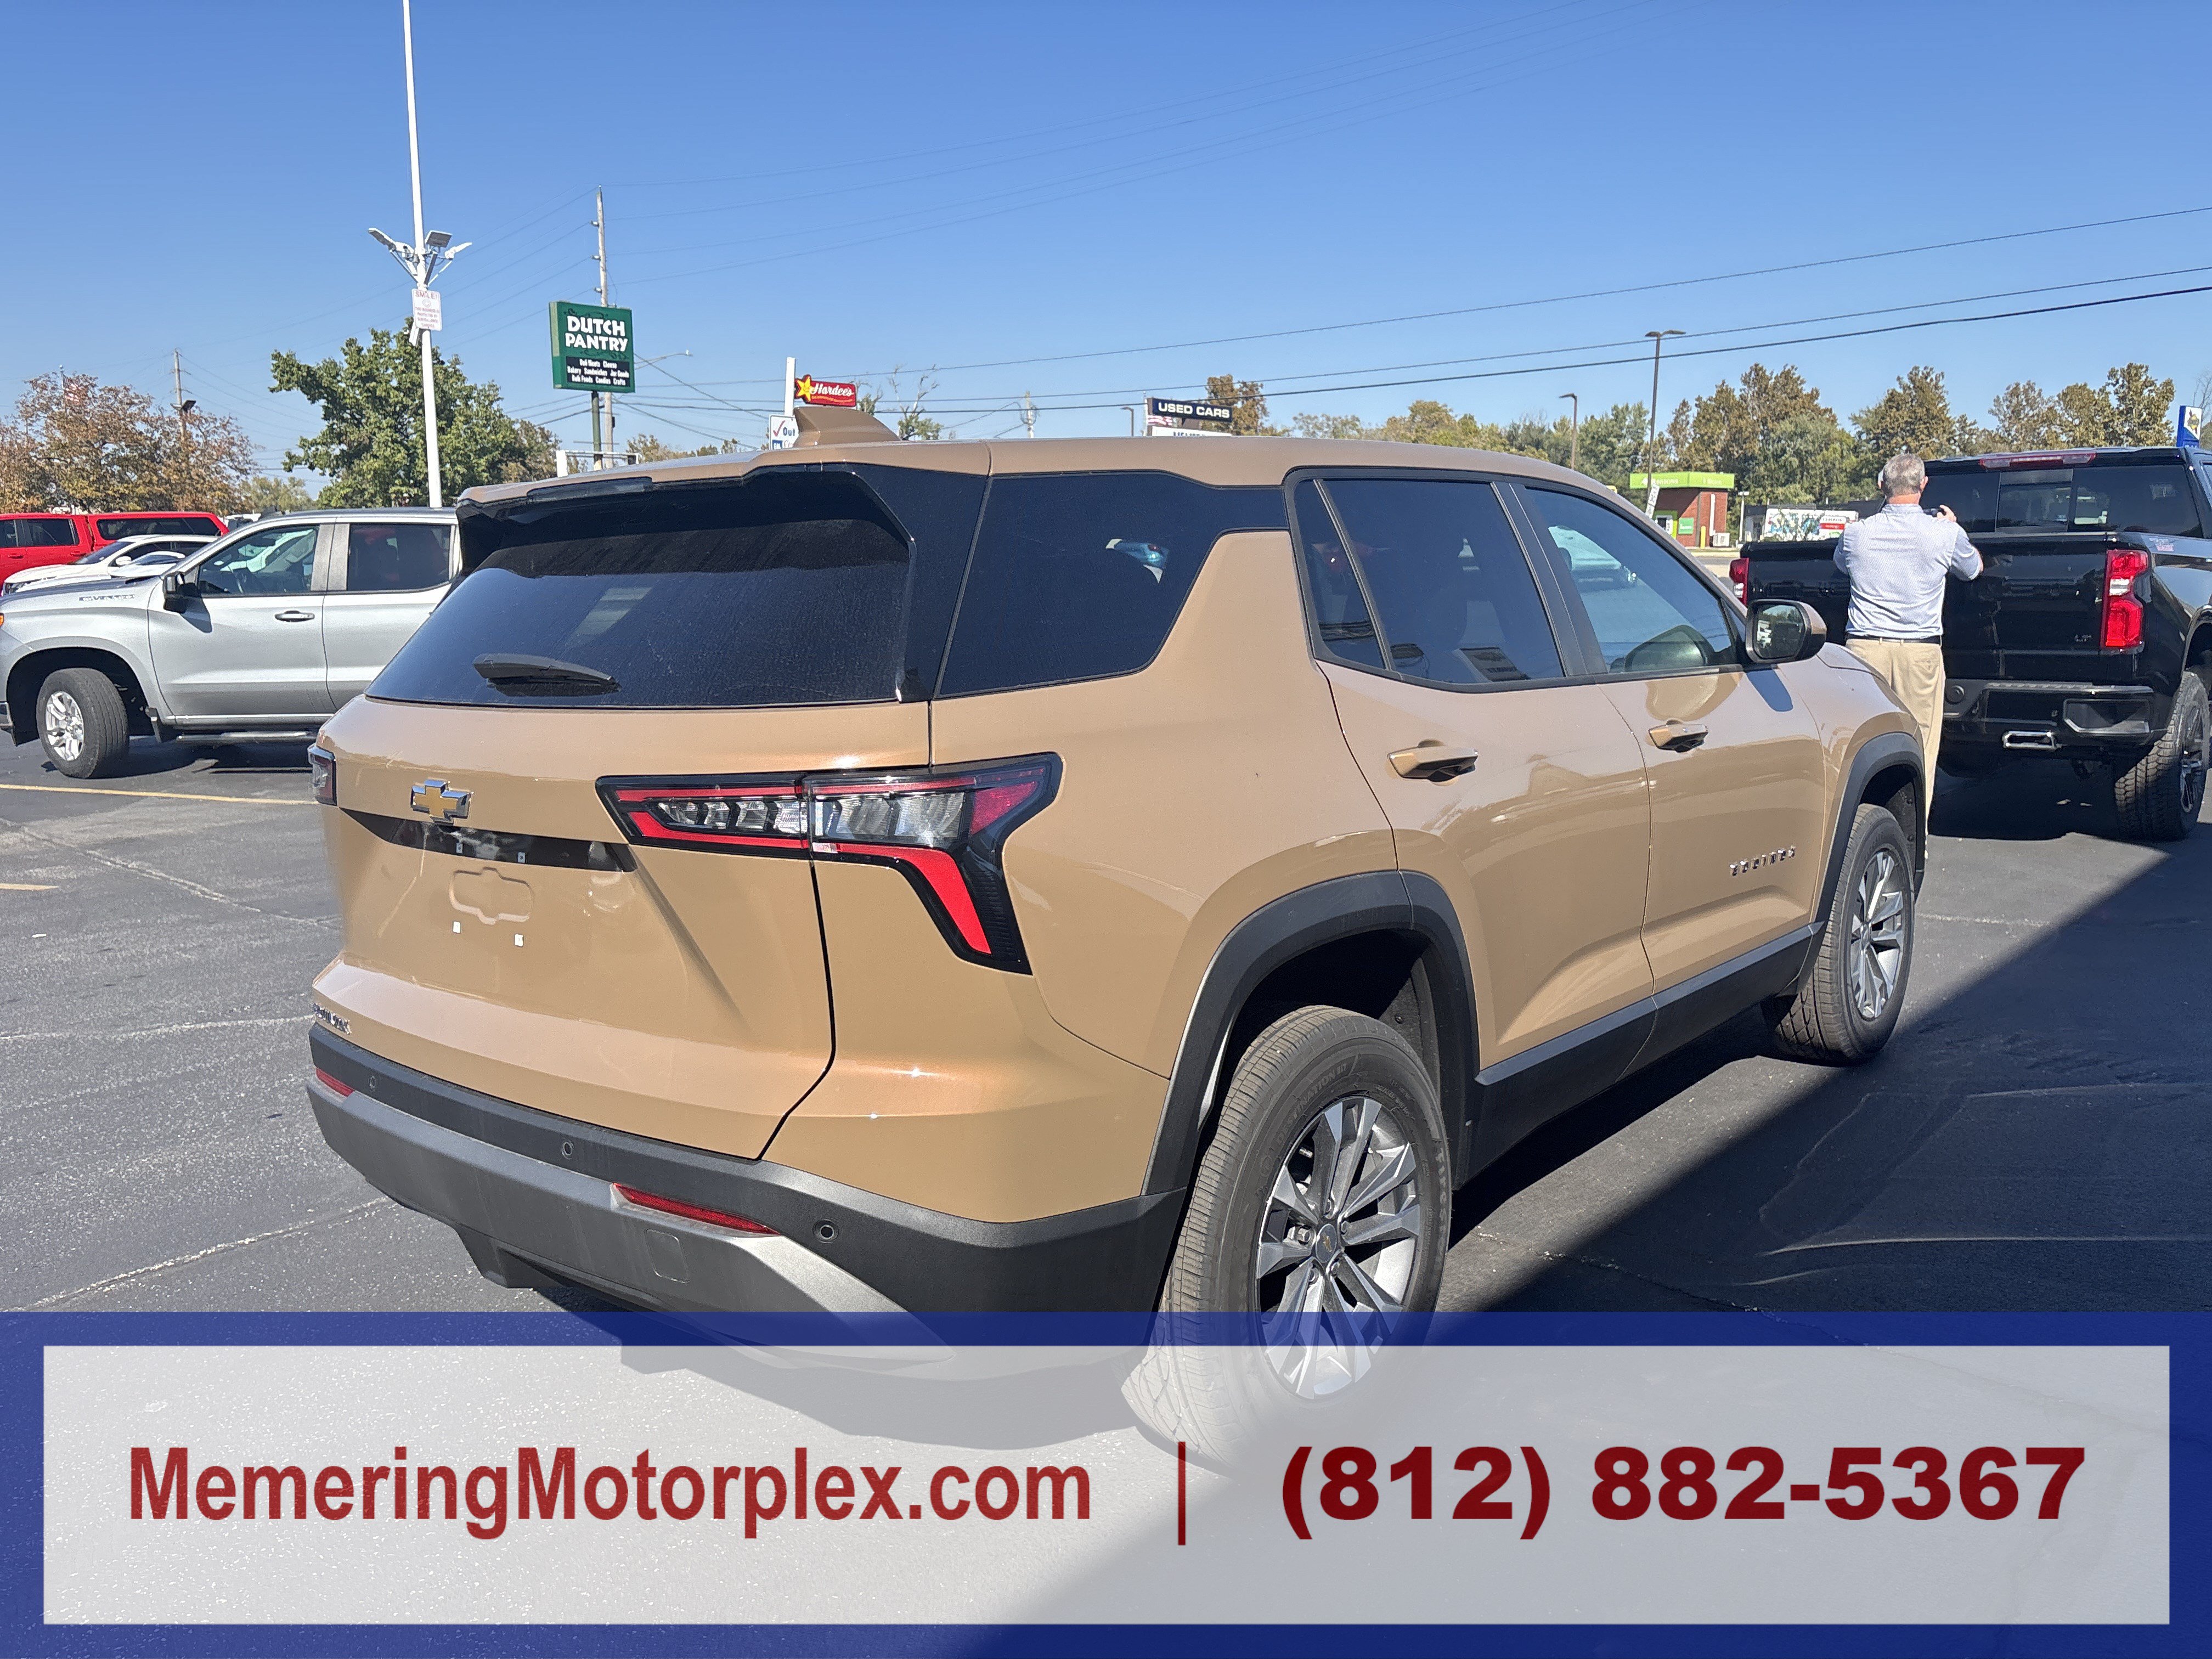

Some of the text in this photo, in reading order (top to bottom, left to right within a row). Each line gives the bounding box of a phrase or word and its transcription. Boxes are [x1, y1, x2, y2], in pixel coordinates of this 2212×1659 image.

[416, 291, 437, 300] SMILE!
[567, 315, 625, 336] DUTCH
[565, 332, 628, 352] PANTRY
[567, 365, 582, 375] Bakery
[584, 367, 607, 376] Sandwiches
[809, 383, 855, 397] Hardee's
[1158, 402, 1230, 419] USED CARS
[783, 427, 795, 436] Out
